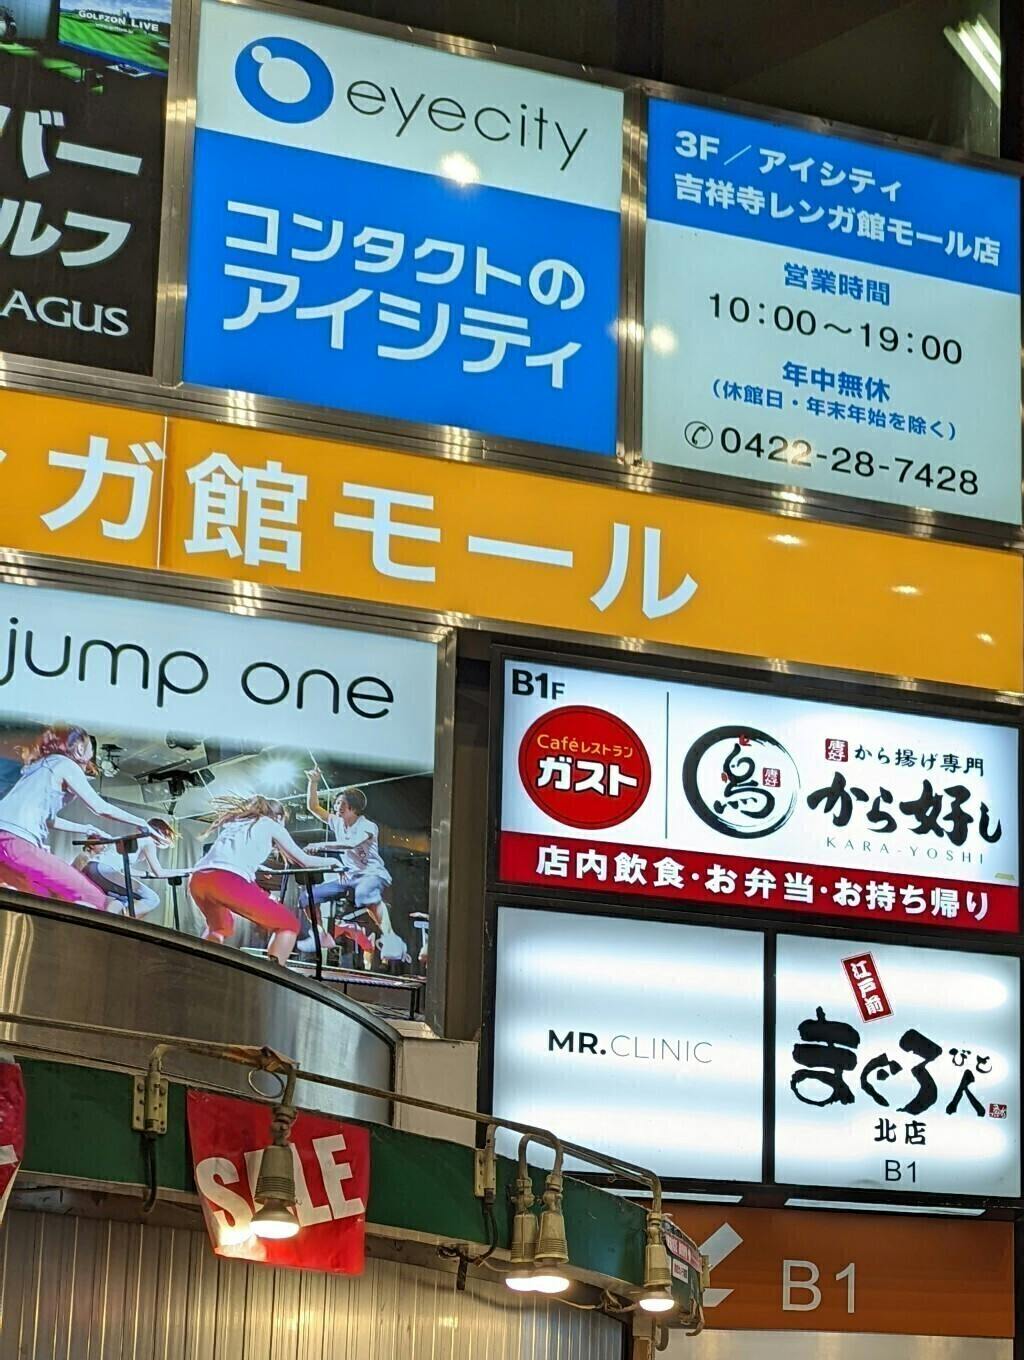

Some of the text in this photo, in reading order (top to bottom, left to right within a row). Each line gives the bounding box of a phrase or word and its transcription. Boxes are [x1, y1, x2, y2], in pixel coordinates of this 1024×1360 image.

[78, 8, 126, 25] GOLFZON
[131, 18, 159, 32] LIVE
[346, 79, 589, 171] eyecity
[674, 172, 1000, 266] 吉祥寺レンガ館モール店
[223, 200, 586, 311] コンタクトの
[783, 262, 890, 306] 営業時間
[223, 263, 582, 389] アイシティ
[782, 362, 890, 401] 年中無休
[720, 427, 979, 496] 0422-28-7428
[0, 435, 698, 619] ガ館モール
[0, 617, 394, 719] jump one
[511, 668, 565, 701] B1F
[537, 756, 638, 797] ガスト
[854, 744, 984, 777] から揚げ専門
[806, 771, 1002, 847] から好し
[826, 836, 984, 865] KARA-YOSHI
[850, 959, 884, 1016] 江戸前
[874, 1117, 927, 1145] 北店
[884, 1159, 918, 1183] B1
[781, 1260, 856, 1314] B1
